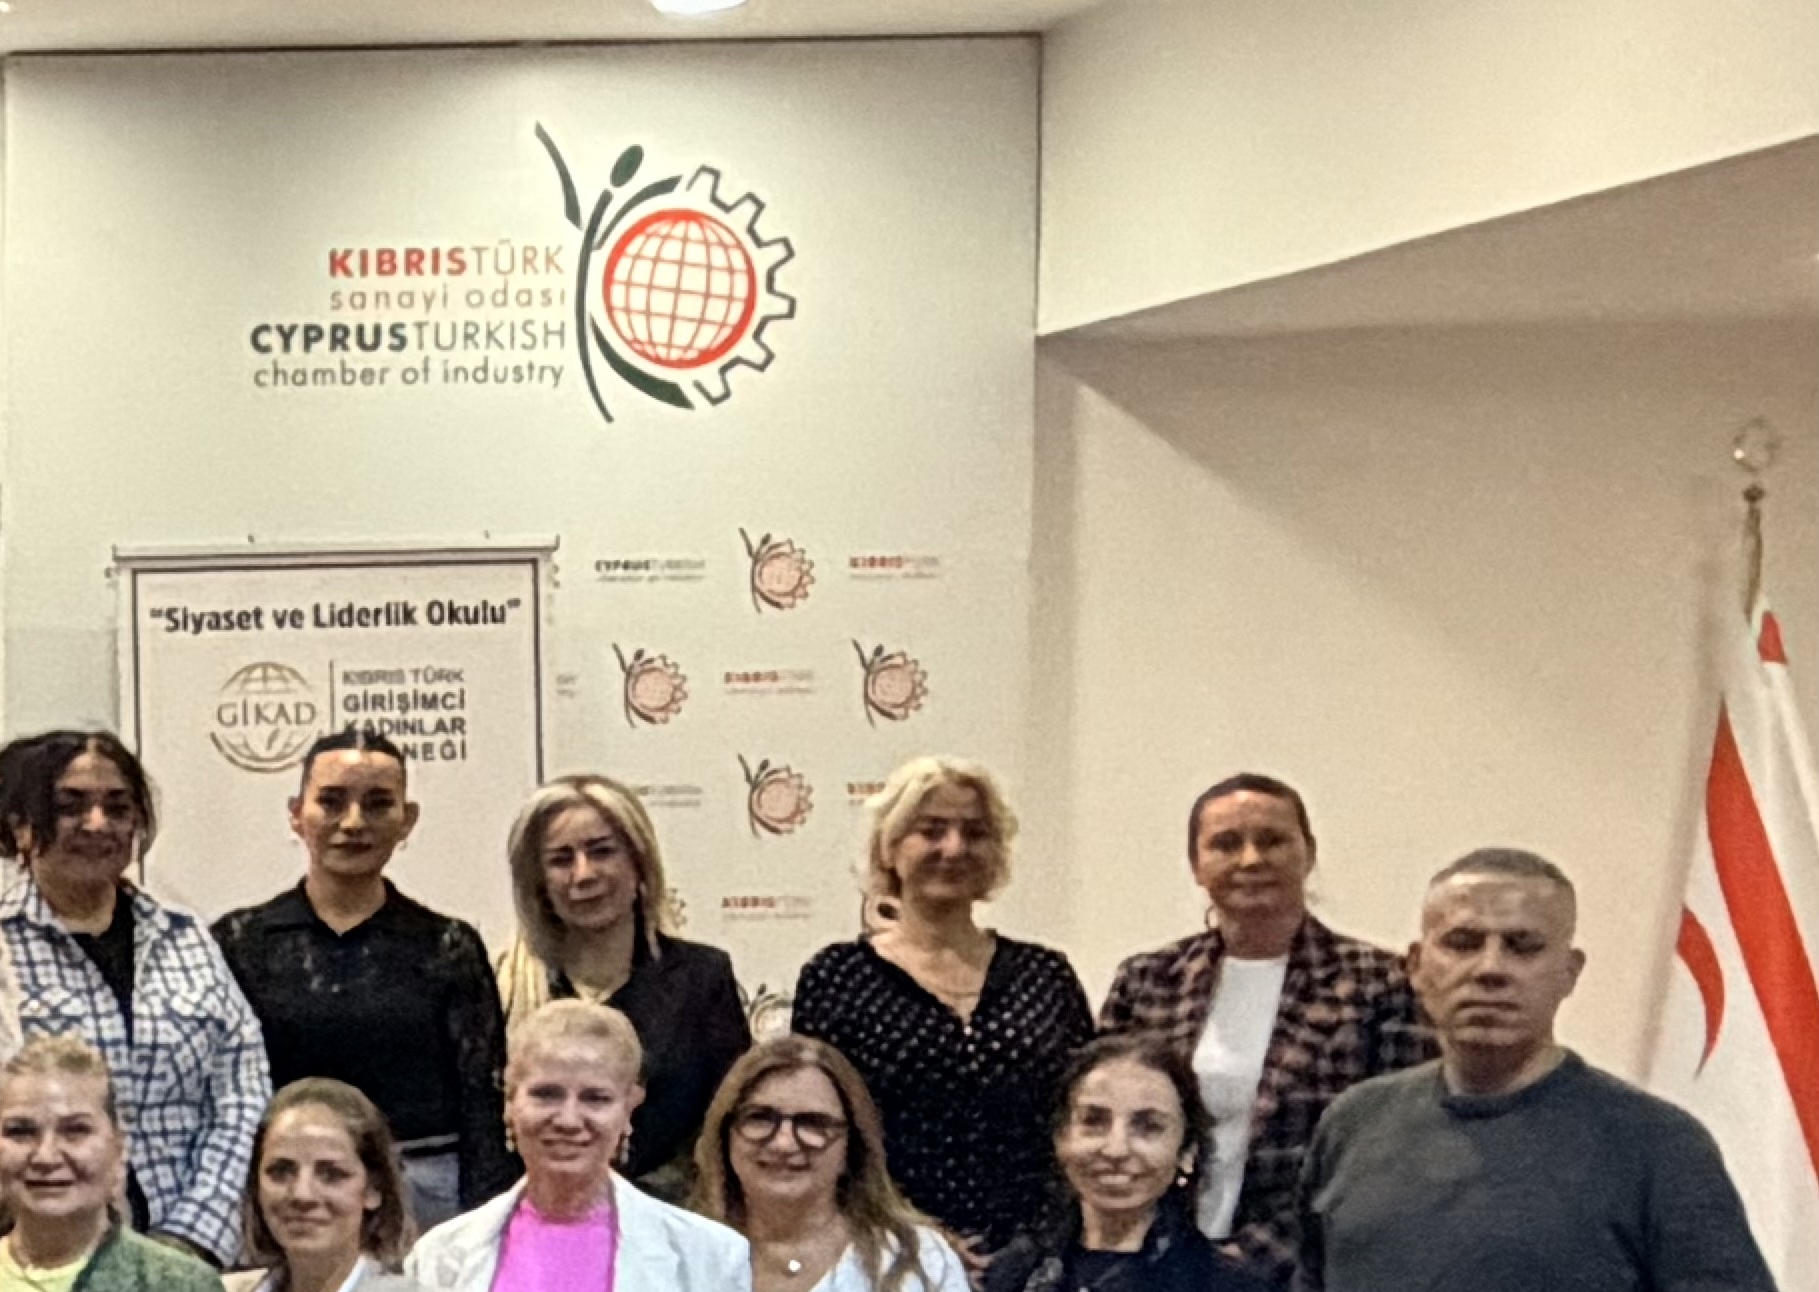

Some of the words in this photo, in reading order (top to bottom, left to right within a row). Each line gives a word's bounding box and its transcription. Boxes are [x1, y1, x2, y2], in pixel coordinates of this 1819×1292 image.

[328, 239, 565, 278] KIBRISTÜRK
[330, 283, 449, 314] sanayi
[465, 279, 566, 309] odası
[250, 320, 566, 354] CYPRUSTURKISH
[253, 358, 390, 388] chamber
[401, 355, 430, 385] of
[443, 356, 565, 388] industry
[272, 608, 305, 630] ve
[312, 601, 418, 629] Liderlik
[217, 698, 317, 728] GİKAD
[402, 738, 467, 762] NEĞİ
